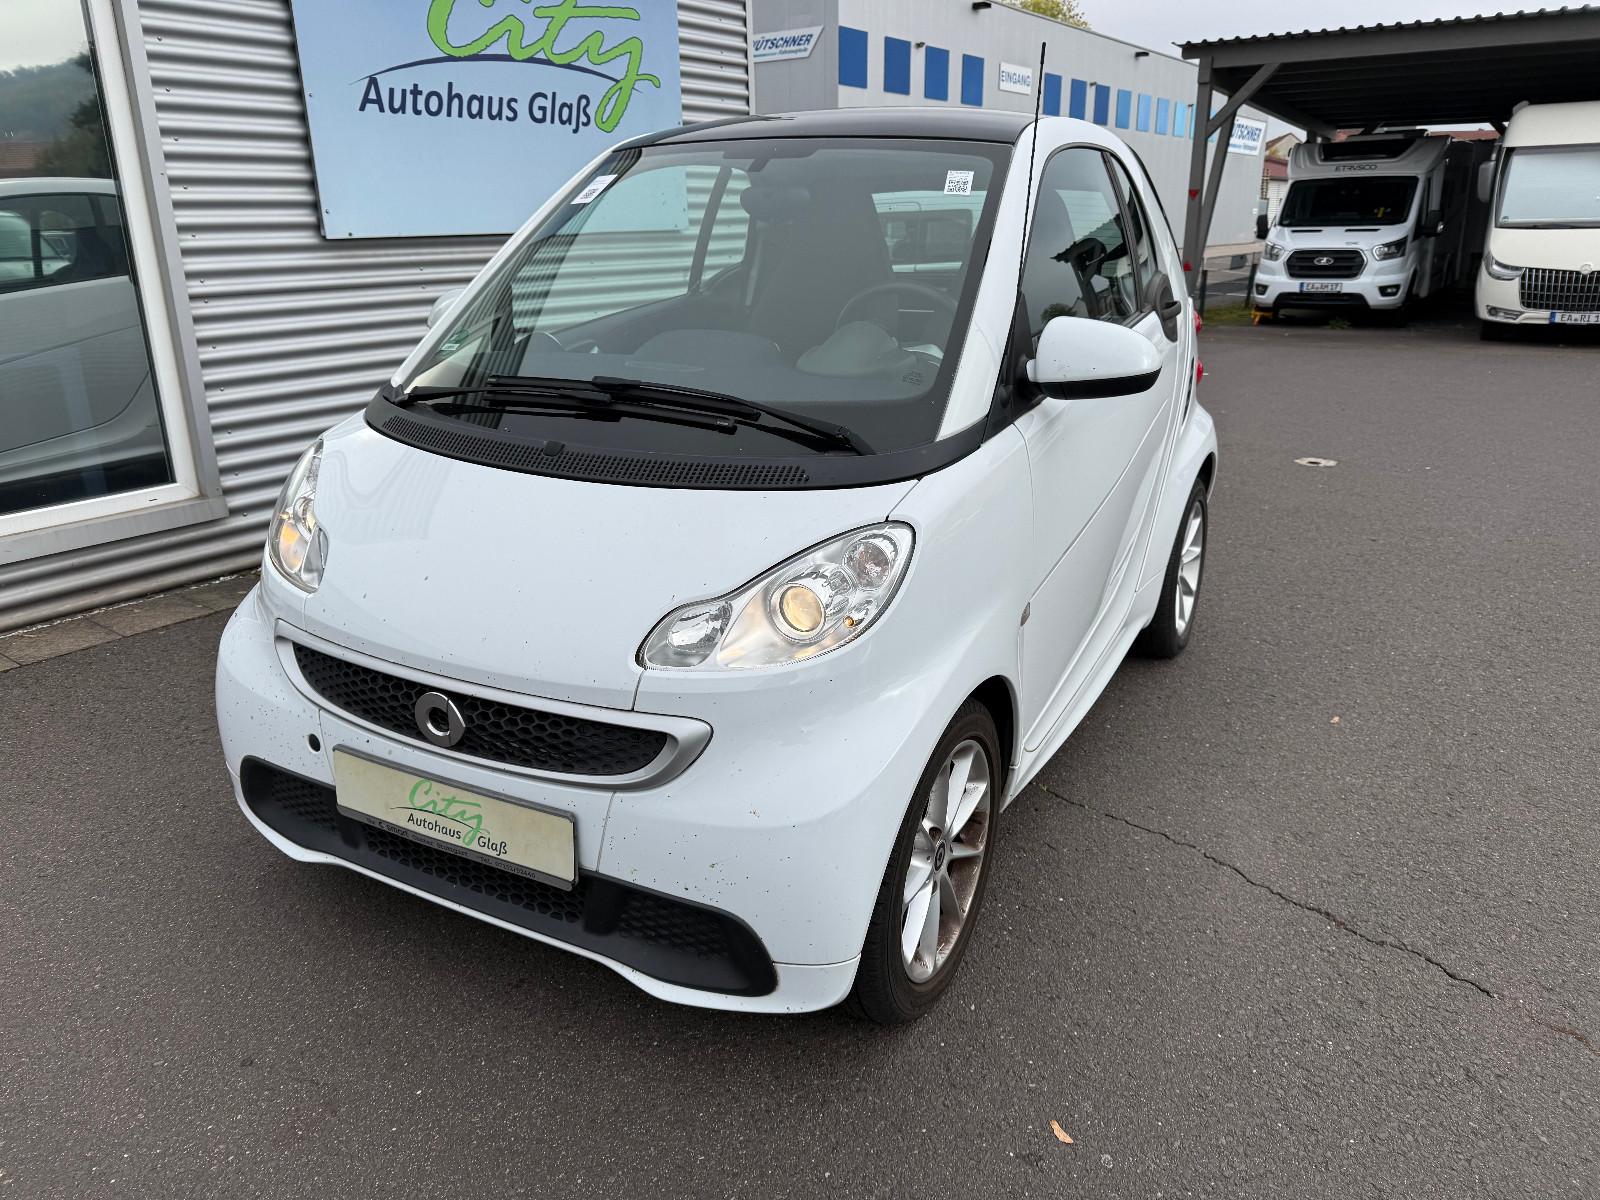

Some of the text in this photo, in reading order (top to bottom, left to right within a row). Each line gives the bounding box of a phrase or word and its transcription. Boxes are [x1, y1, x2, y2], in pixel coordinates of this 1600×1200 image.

[1001, 70, 1031, 86] EINGANG
[358, 76, 591, 134] Autohaus Glaß
[1561, 313, 1573, 322] EA
[407, 813, 508, 857] Autohaus Glaß
[408, 779, 491, 848] City
